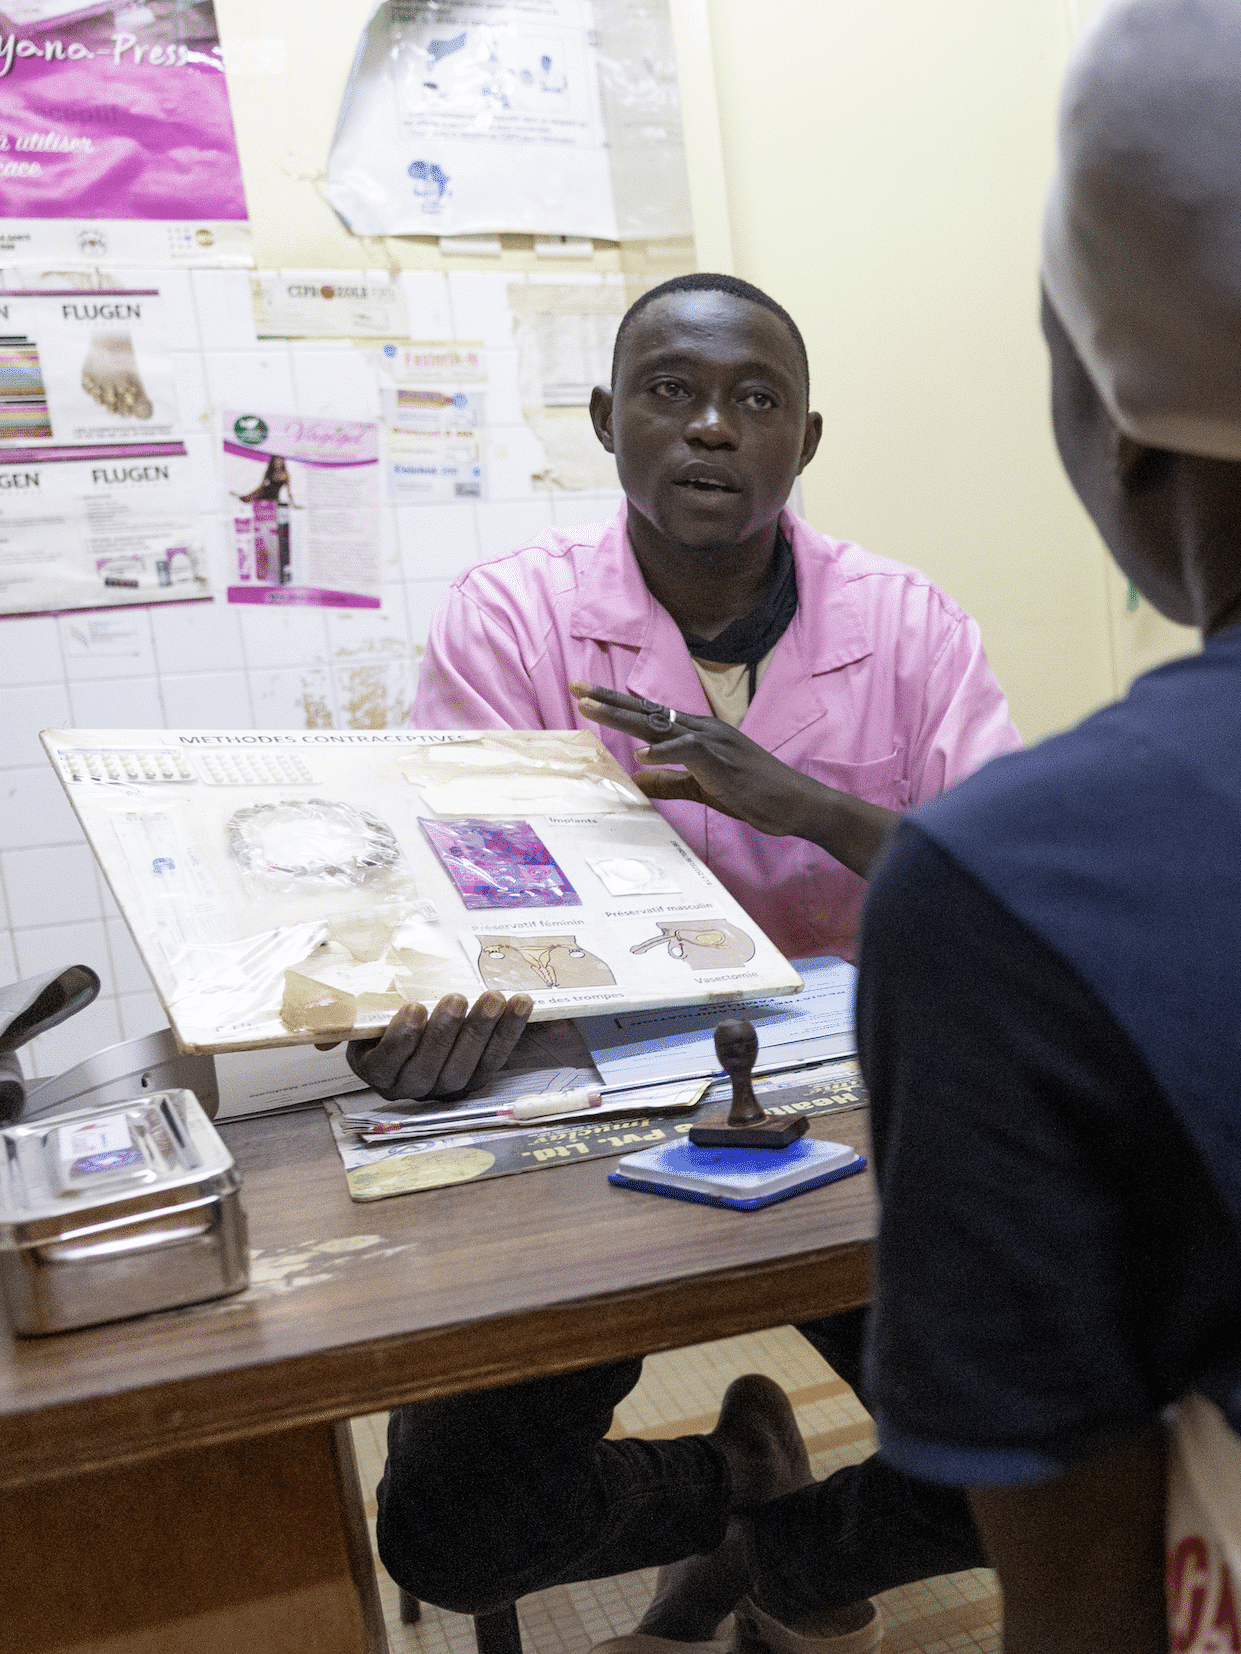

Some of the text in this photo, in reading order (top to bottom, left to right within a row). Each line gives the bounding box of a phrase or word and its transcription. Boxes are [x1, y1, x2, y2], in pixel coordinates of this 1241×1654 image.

[62, 304, 141, 320] FLUGEN
[92, 465, 169, 484] FLUGEN
[179, 734, 467, 744] METHODES CONTRACEPTIVES
[549, 816, 598, 825] Implants
[605, 902, 714, 918] Préservatif masculin
[471, 918, 585, 932] Préservatif féminin
[694, 969, 759, 985] Vasectomie
[551, 994, 570, 1004] des
[573, 991, 625, 1004] trompes
[597, 1128, 667, 1148] Pvt.
[521, 1142, 590, 1162] Ltd.
